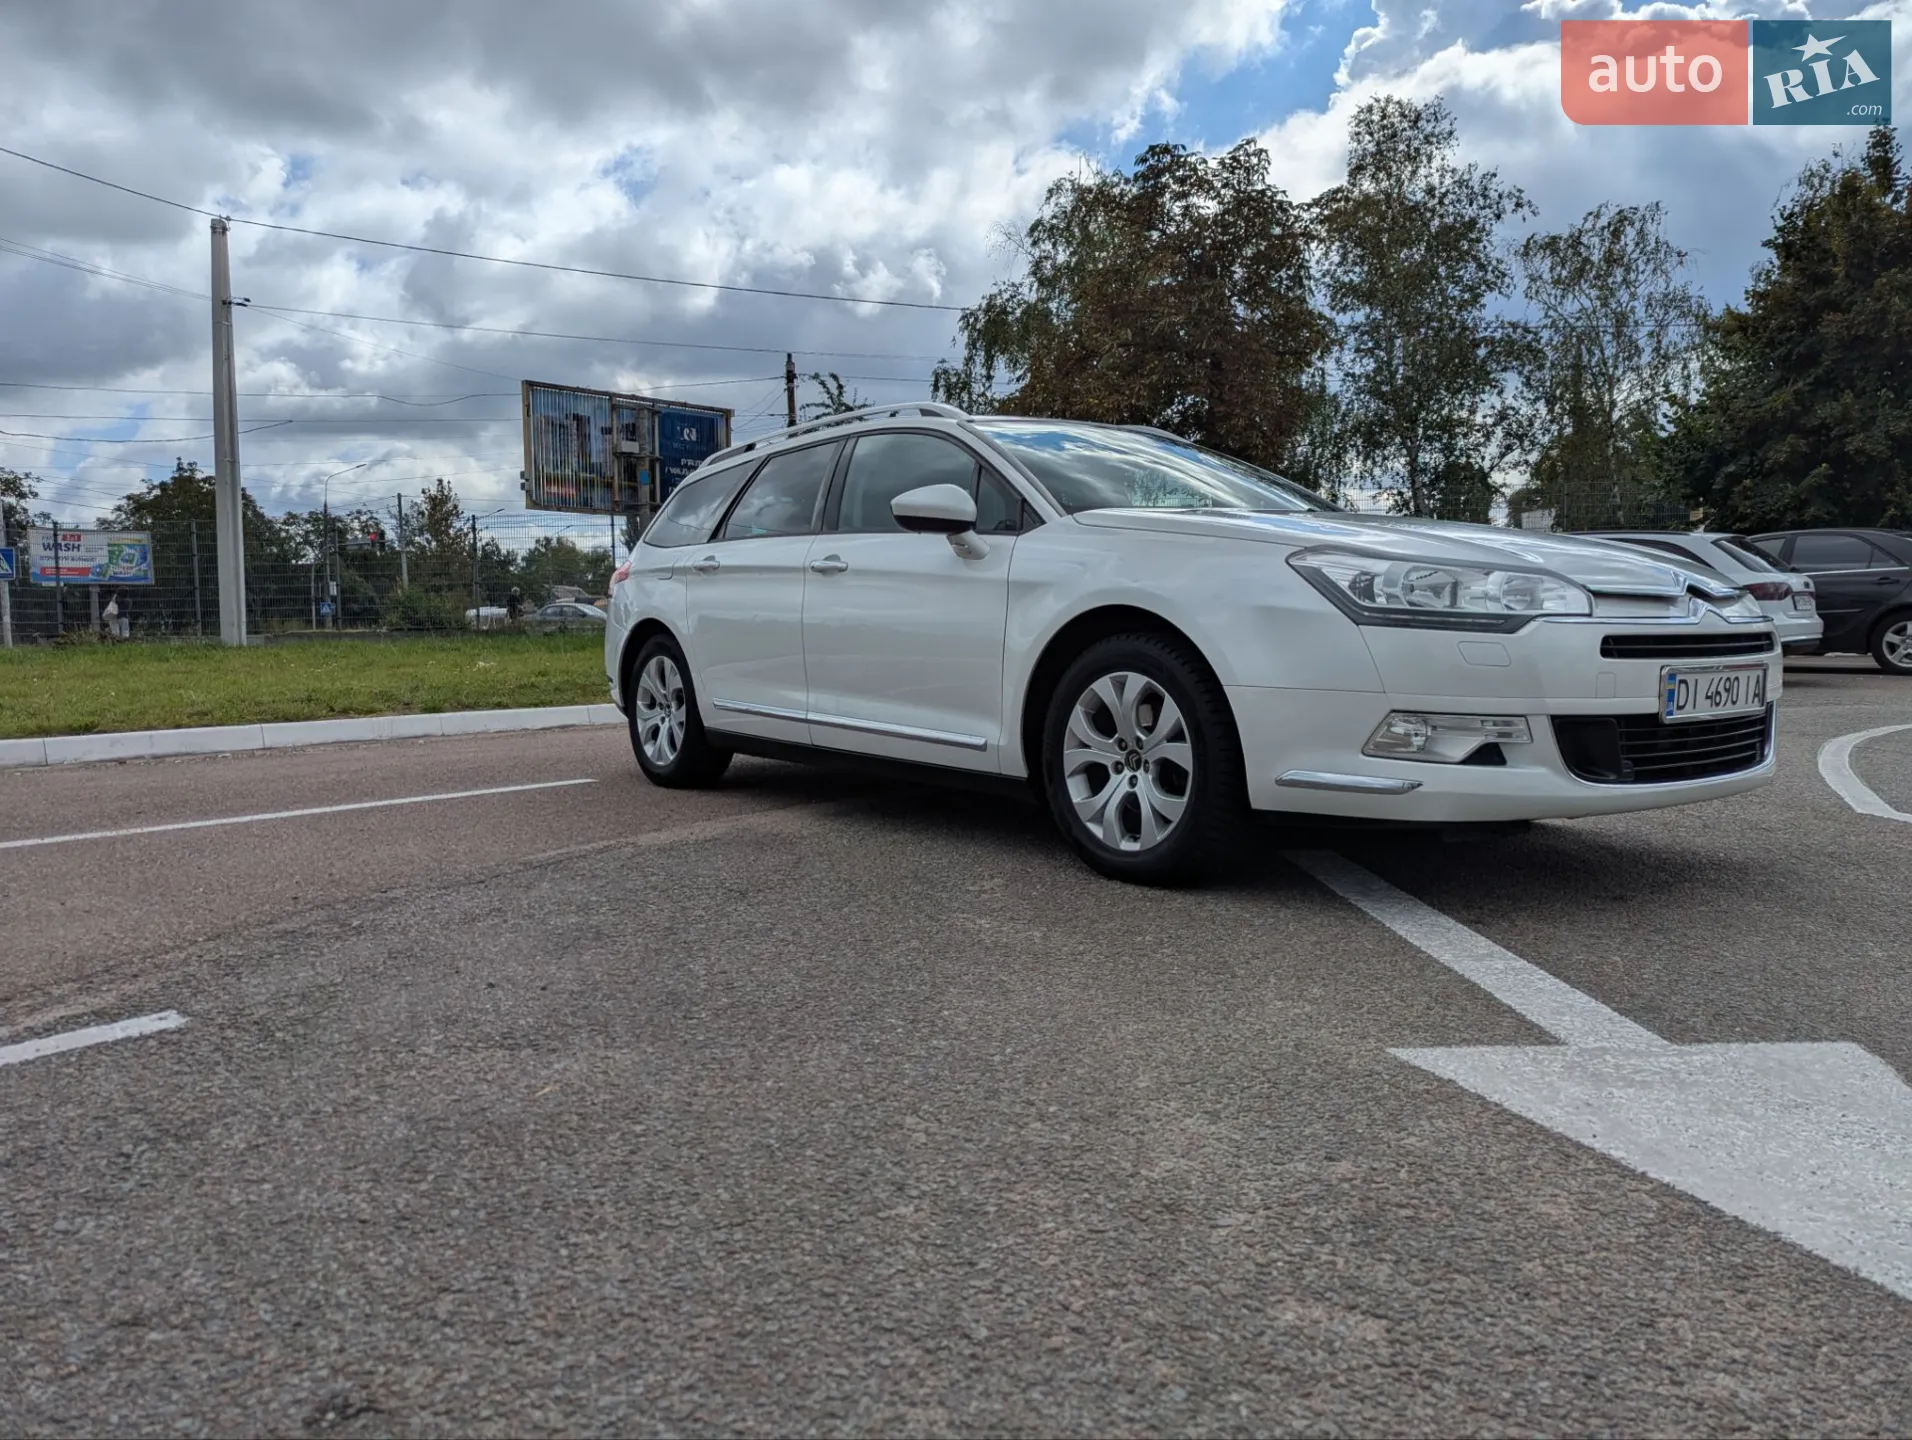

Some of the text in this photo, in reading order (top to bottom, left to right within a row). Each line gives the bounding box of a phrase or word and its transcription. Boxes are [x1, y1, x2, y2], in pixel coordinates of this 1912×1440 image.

[1676, 674, 1761, 711] DI 4690 IA
